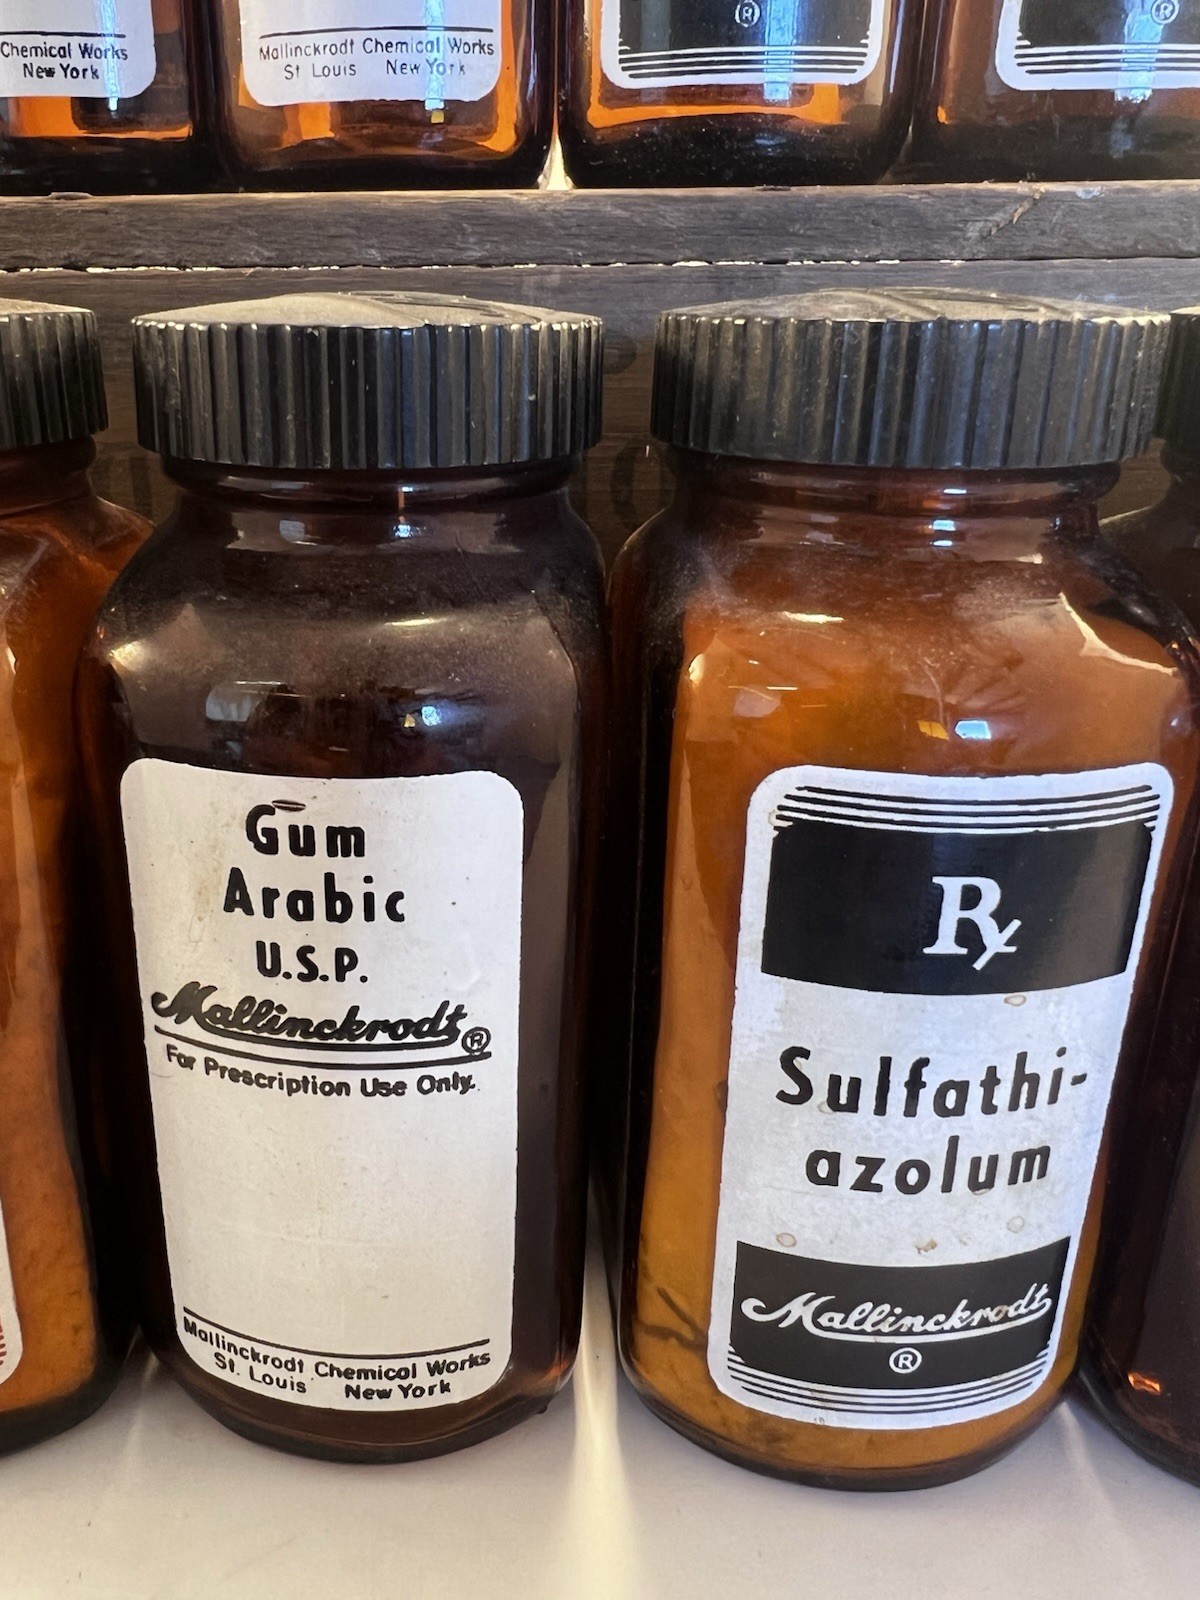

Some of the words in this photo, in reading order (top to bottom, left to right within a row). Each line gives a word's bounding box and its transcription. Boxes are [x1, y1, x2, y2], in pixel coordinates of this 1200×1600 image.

[0, 41, 72, 59] Chemical
[78, 42, 128, 61] Works
[23, 62, 56, 79] New
[60, 63, 99, 79] York
[260, 38, 354, 60] Mallinckrodt
[362, 37, 441, 54] Chemical
[447, 37, 495, 56] Works
[312, 61, 357, 78] Louis
[386, 59, 421, 75] New
[426, 57, 466, 76] York
[246, 804, 366, 858] Gum
[223, 867, 406, 923] Arabic
[256, 941, 368, 984] U.S.P.
[151, 981, 468, 1052] Mallinckrodt
[166, 1043, 196, 1070] For
[204, 1056, 350, 1097] Prescription
[360, 1077, 407, 1097] Use
[776, 1046, 1088, 1118] Sulfathi-
[806, 1135, 1051, 1195] azolum
[741, 1282, 1053, 1344] Mallinckrodt
[183, 1316, 305, 1374] Mallinckrodt
[314, 1361, 417, 1381] Chemical
[426, 1351, 491, 1377] Works
[249, 1366, 307, 1394] Louis
[345, 1384, 392, 1400] New
[397, 1380, 452, 1399] York
